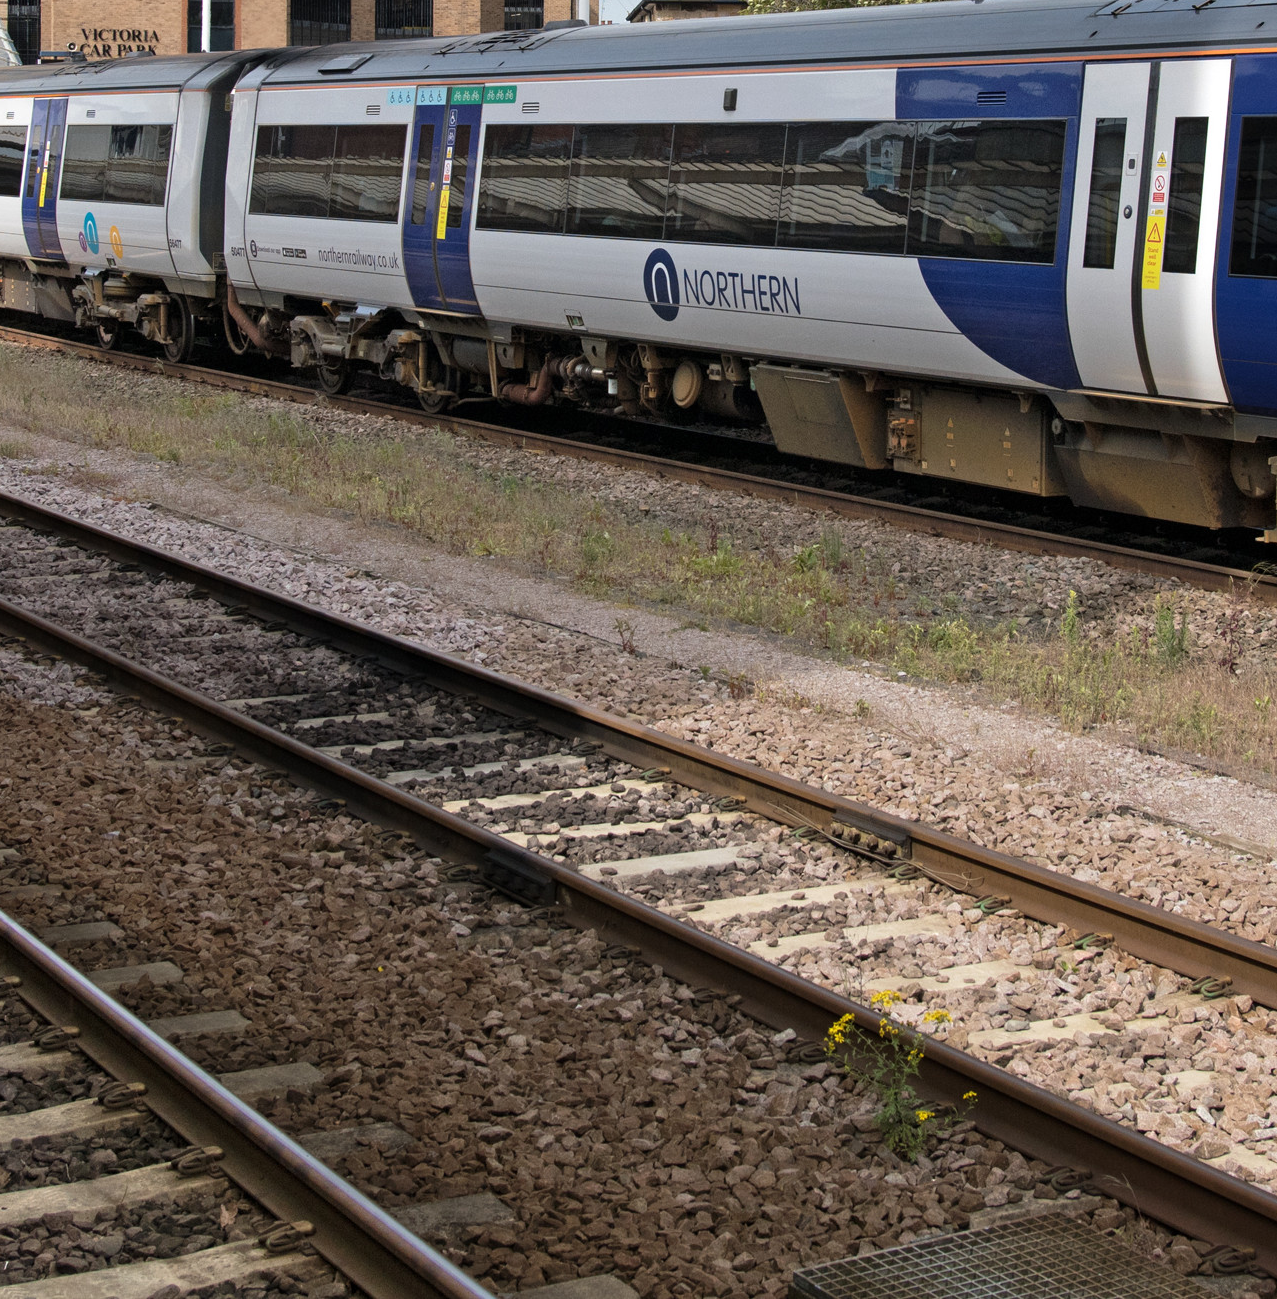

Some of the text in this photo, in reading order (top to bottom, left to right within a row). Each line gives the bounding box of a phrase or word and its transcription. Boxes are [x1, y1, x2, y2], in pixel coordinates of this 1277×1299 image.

[81, 28, 160, 42] VICTORIA
[79, 43, 157, 58] CAR PARK
[318, 246, 400, 271] northernrailway.co.uk
[683, 268, 801, 315] NORTHERN
